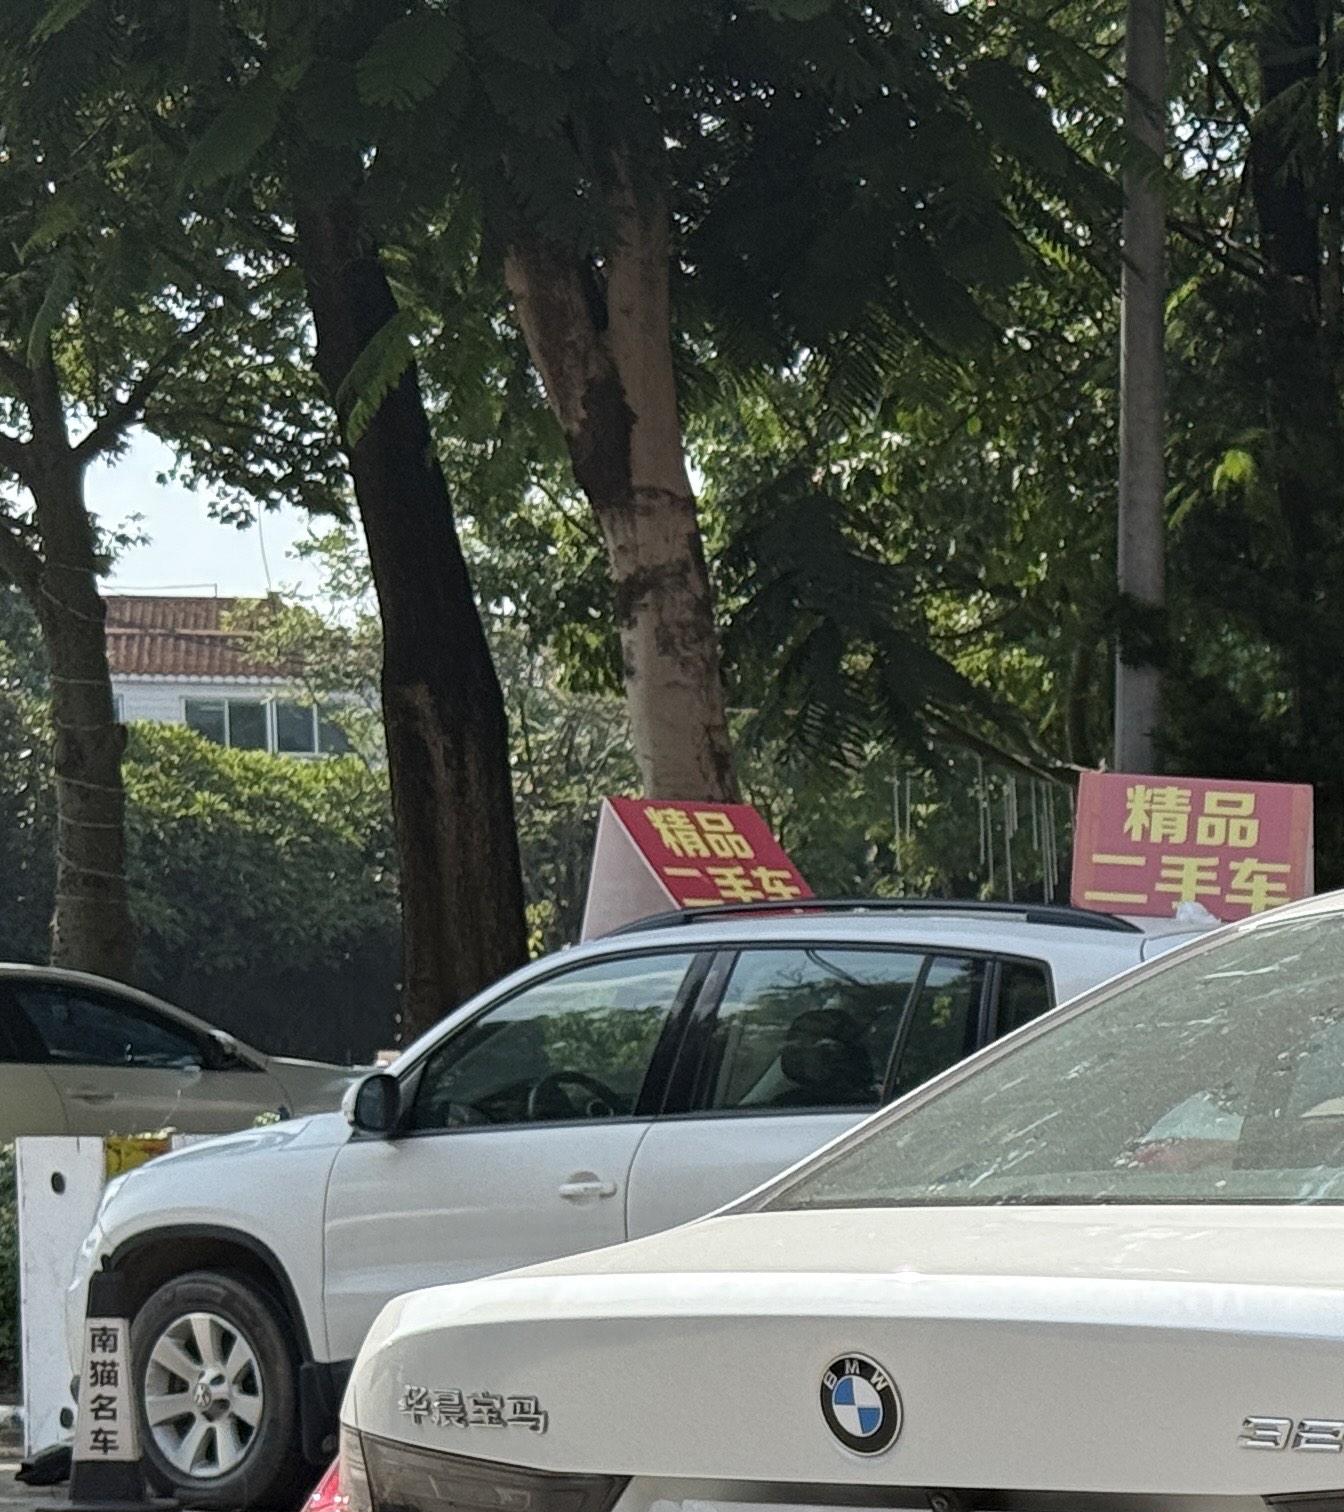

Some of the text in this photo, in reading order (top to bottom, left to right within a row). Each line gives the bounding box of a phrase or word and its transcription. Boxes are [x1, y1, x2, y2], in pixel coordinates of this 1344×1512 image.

[644, 806, 756, 860] 精品
[1123, 784, 1260, 848] 精品
[663, 866, 802, 906] 二手车
[1084, 854, 1292, 914] 二手车
[89, 1325, 120, 1456] 南猫名车
[399, 1384, 550, 1434] 华晨宝马
